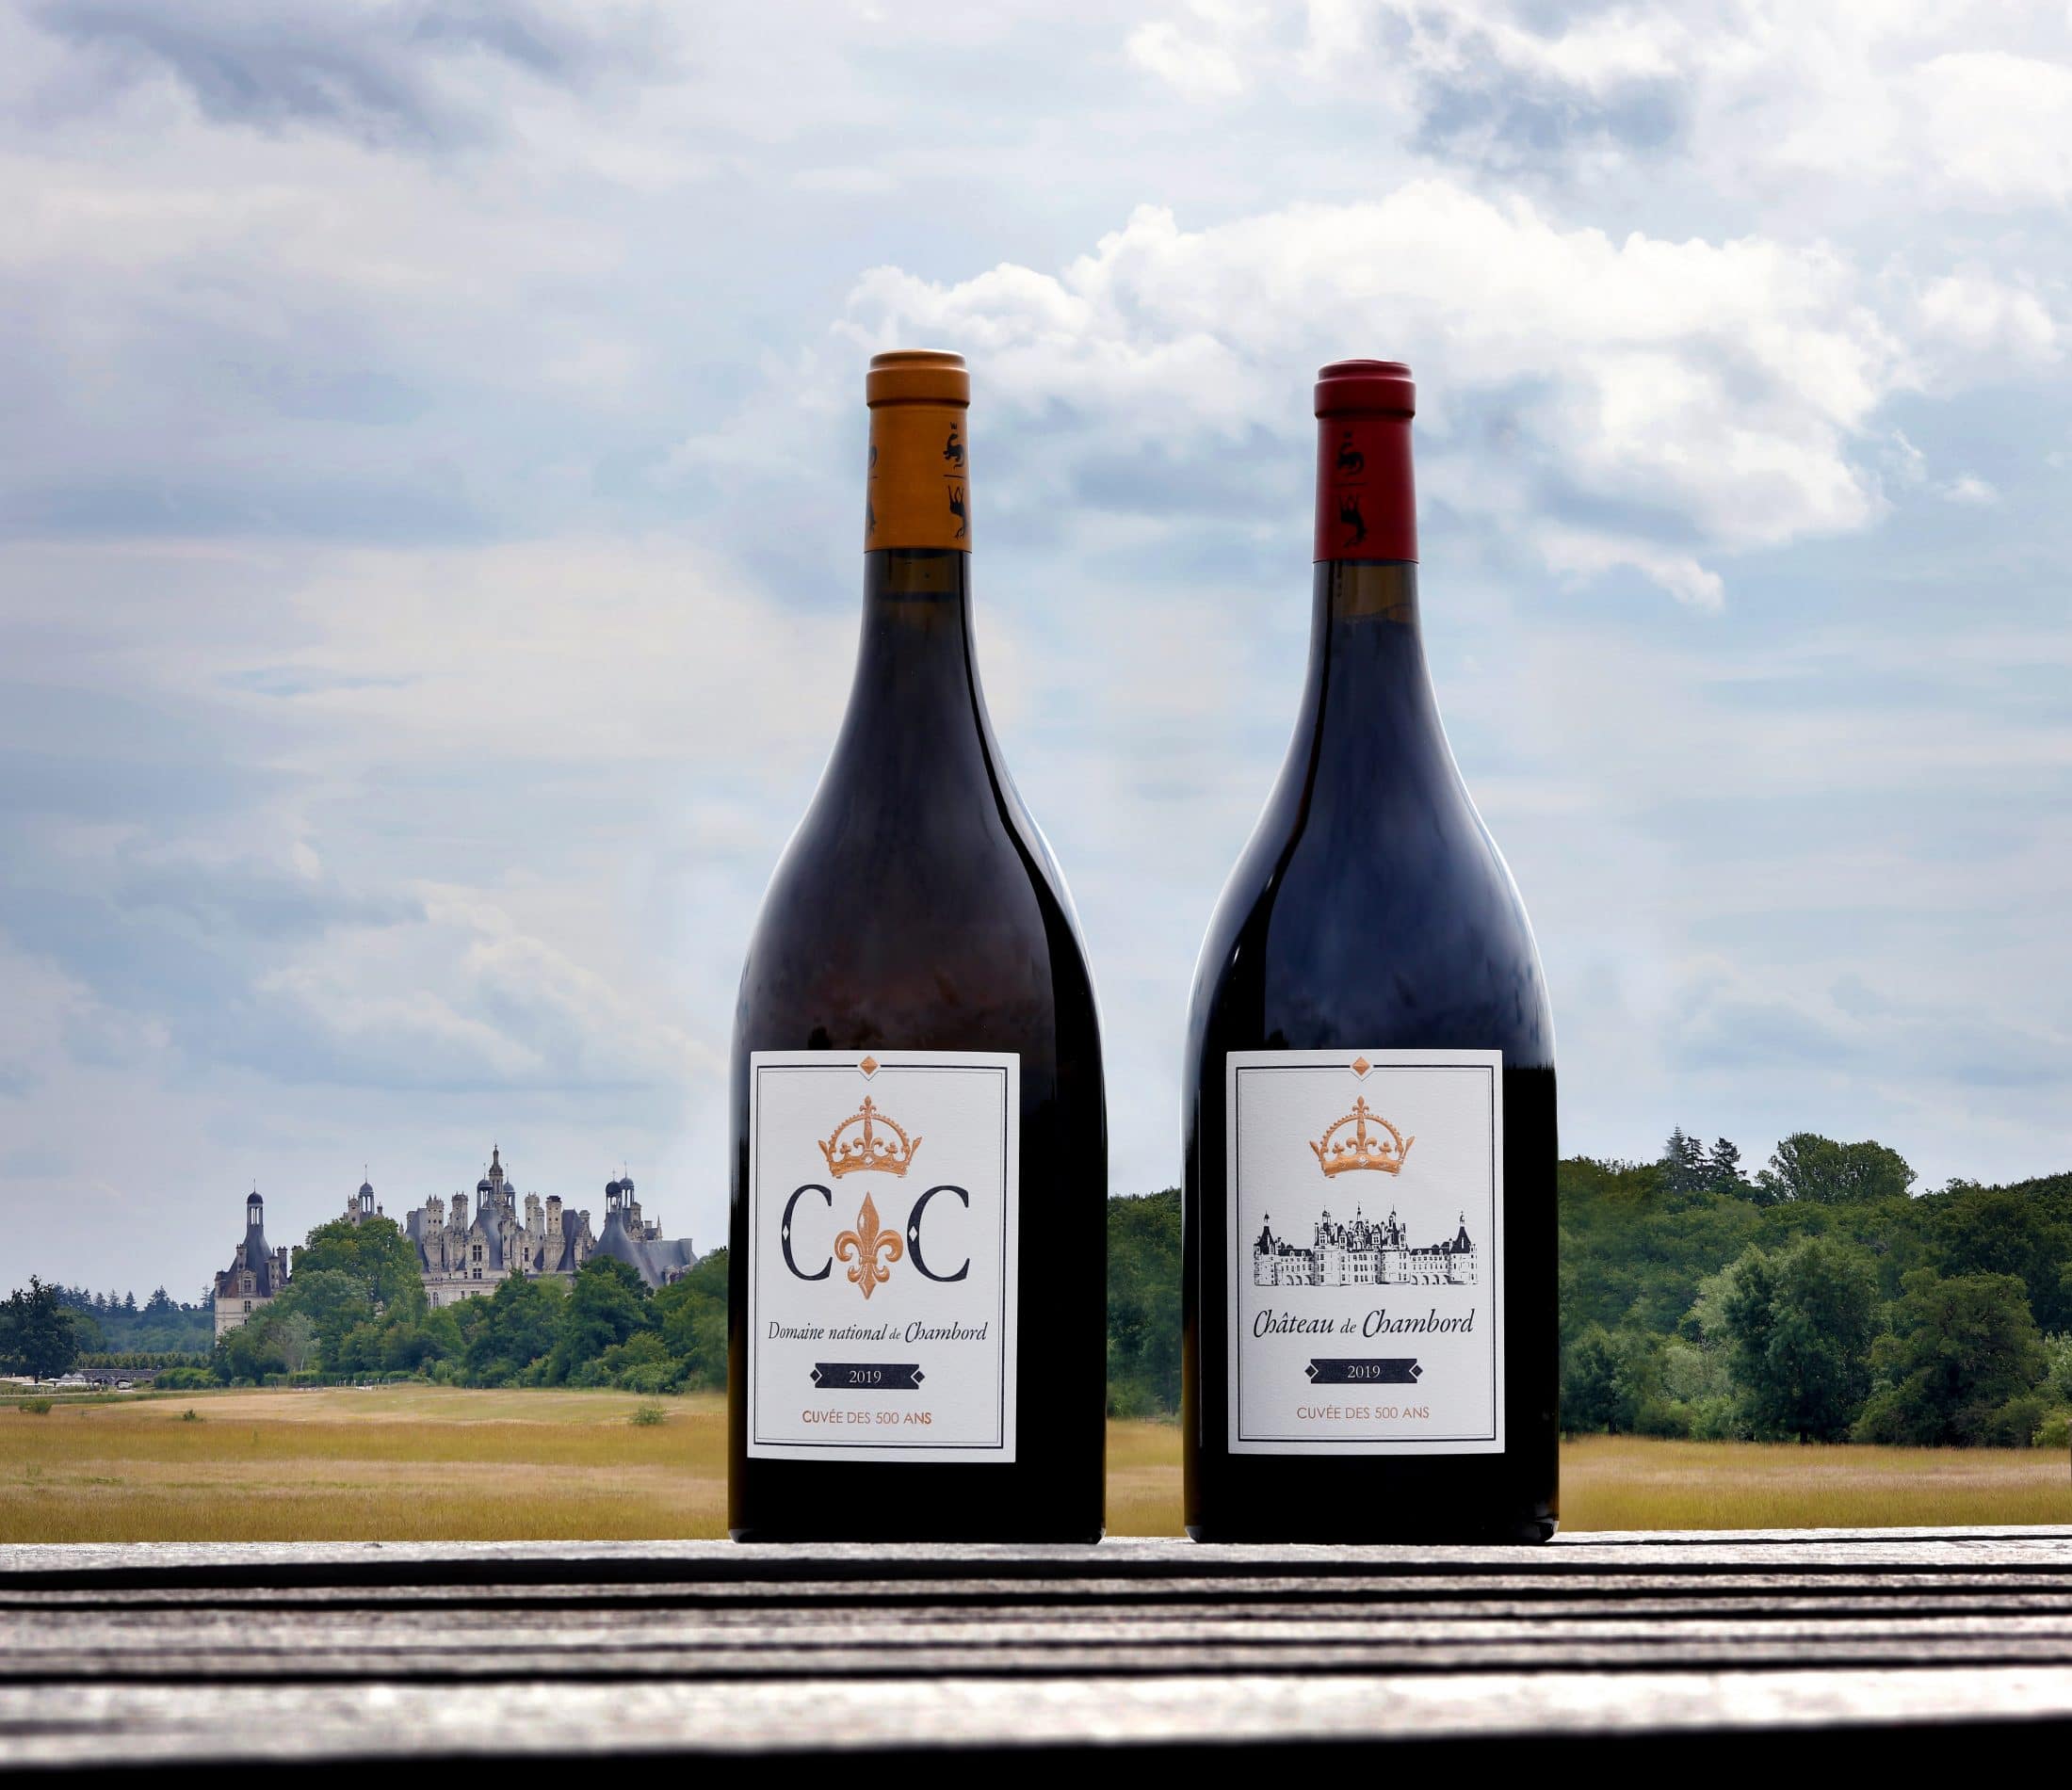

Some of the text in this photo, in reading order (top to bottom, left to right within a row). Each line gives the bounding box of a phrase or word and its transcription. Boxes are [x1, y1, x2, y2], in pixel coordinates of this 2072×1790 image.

[782, 1185, 970, 1282] C C
[768, 1320, 989, 1344] Domaine national de Chambord
[1253, 1308, 1476, 1339] Château de Chambord
[849, 1370, 882, 1383] 2019
[1347, 1364, 1381, 1379] 2019
[801, 1408, 932, 1426] CUVÉE DES 500 ANS
[1296, 1404, 1430, 1421] CUVÉE DES 500 ANS
